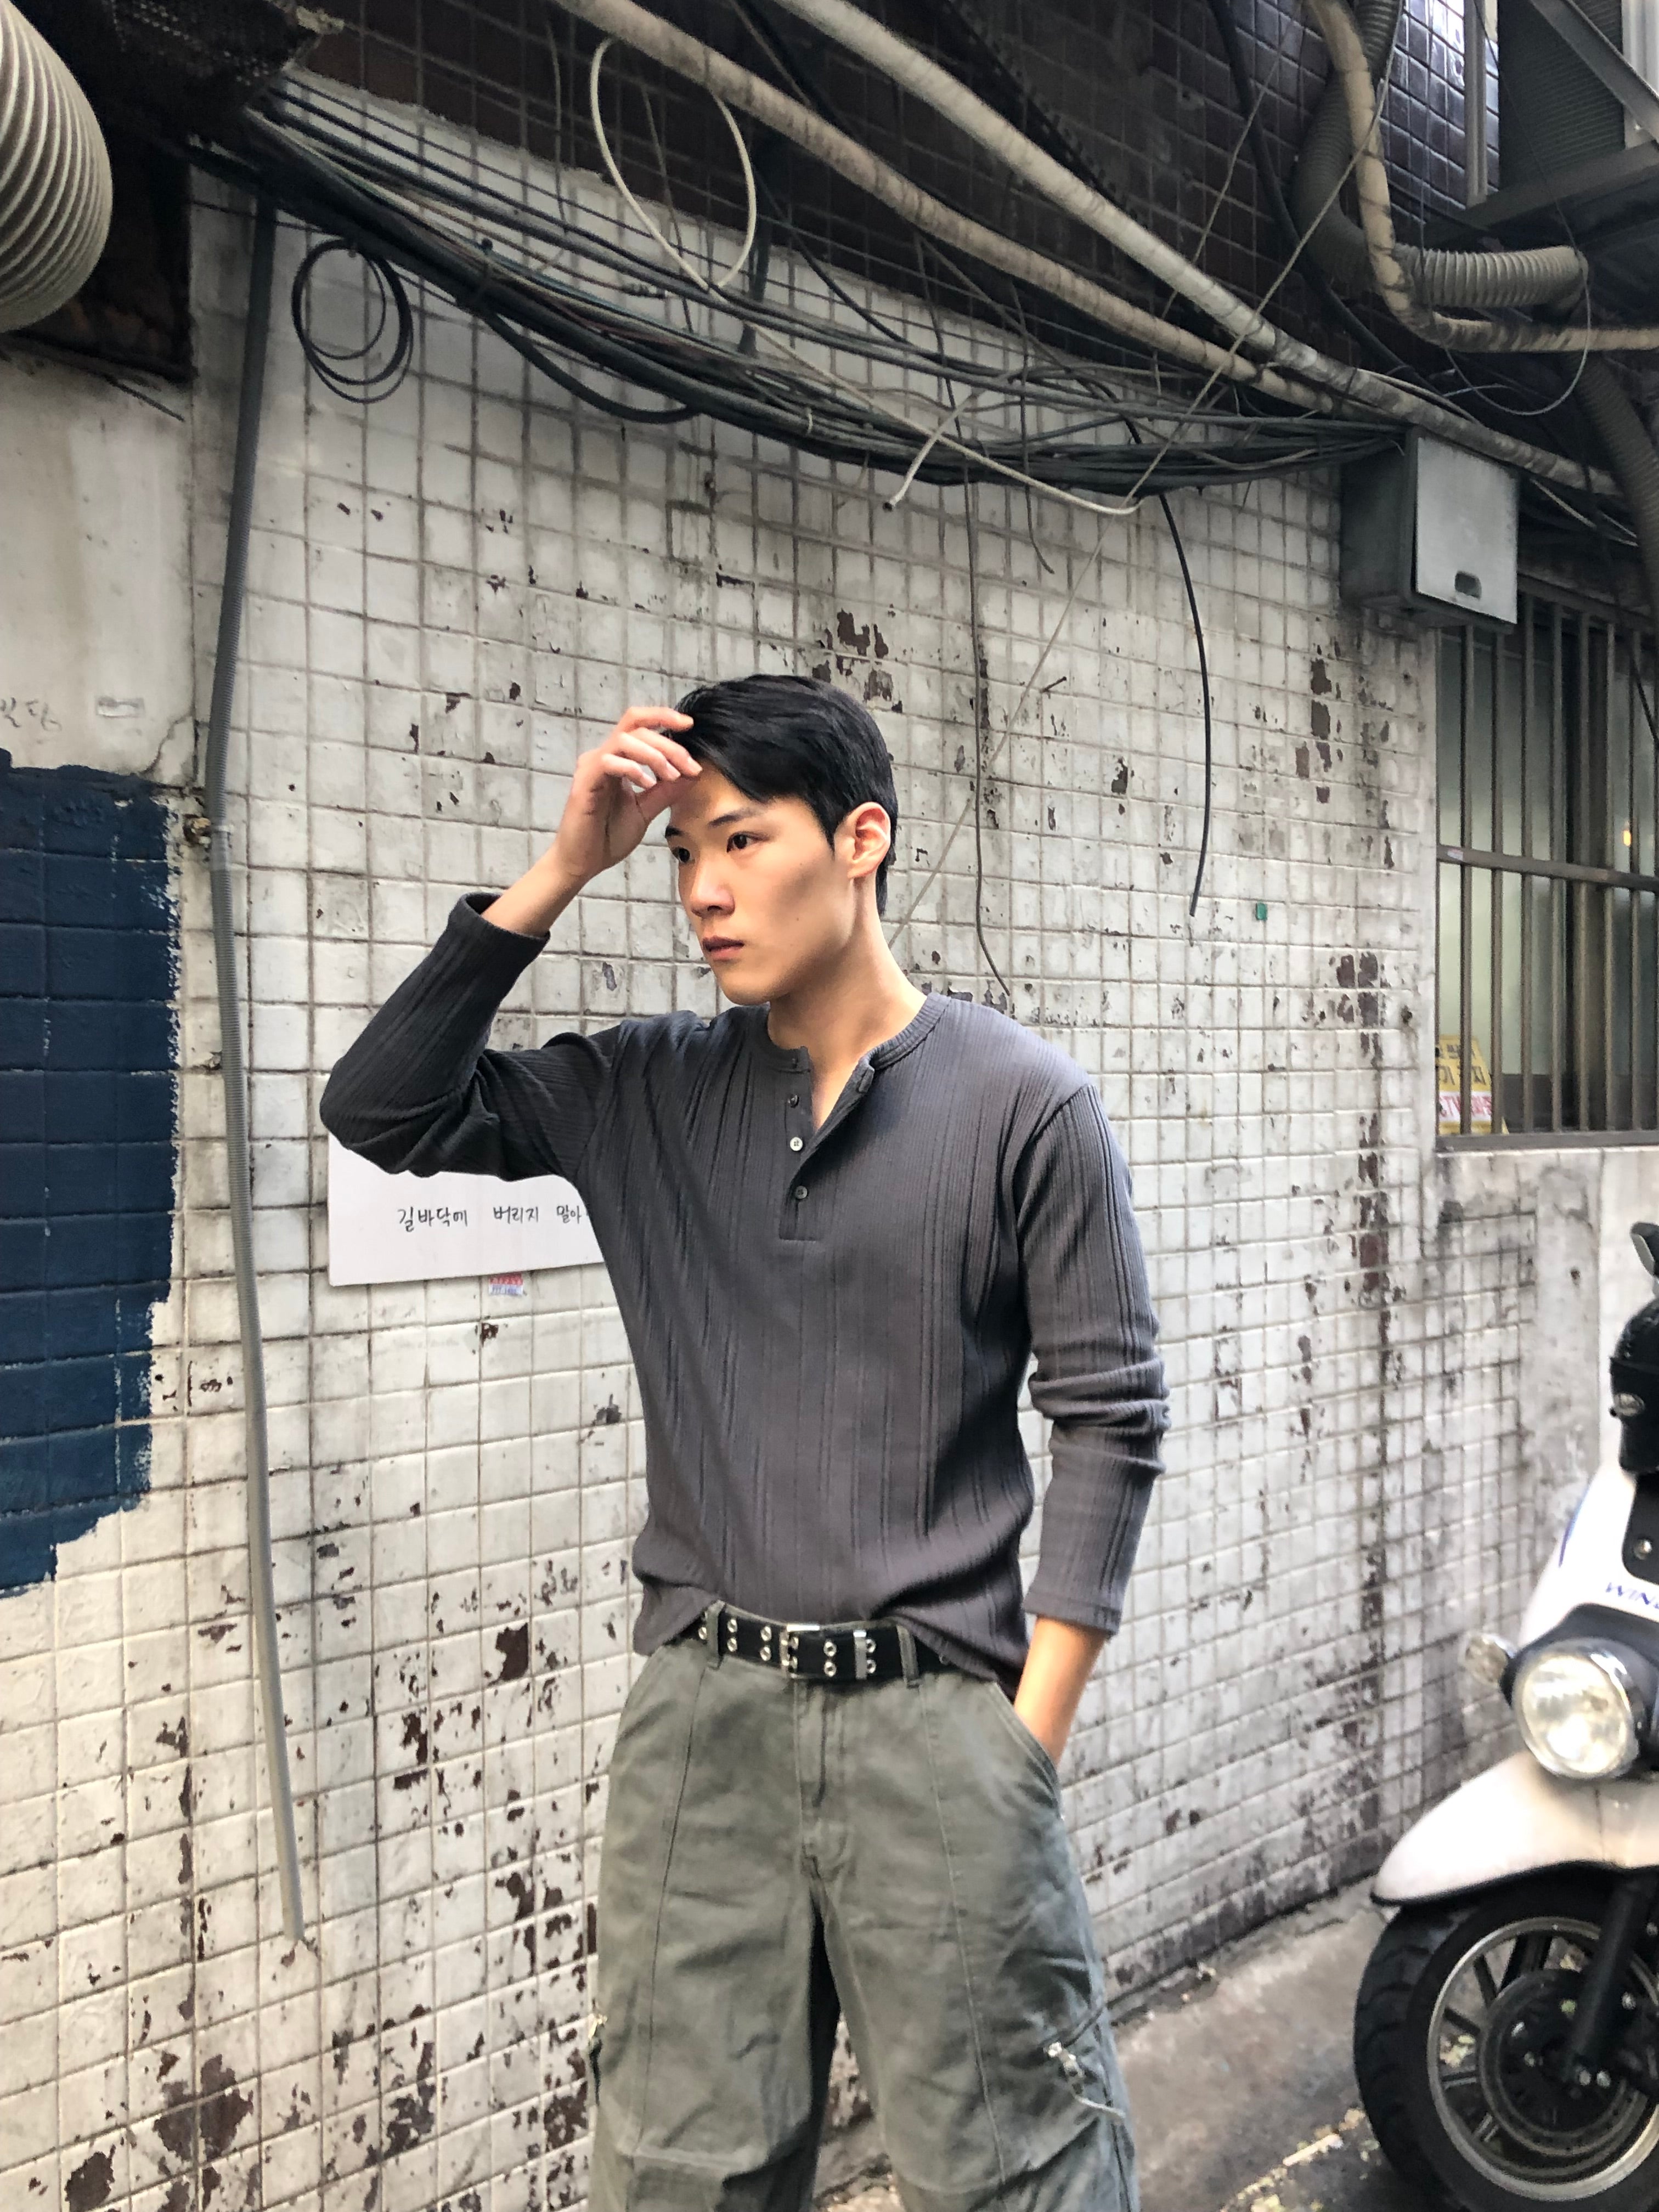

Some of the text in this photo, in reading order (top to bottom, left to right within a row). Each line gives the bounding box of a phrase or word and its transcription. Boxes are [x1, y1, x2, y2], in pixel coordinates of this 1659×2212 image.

[398, 1204, 589, 1232] 길바닥에 버리지 말아
